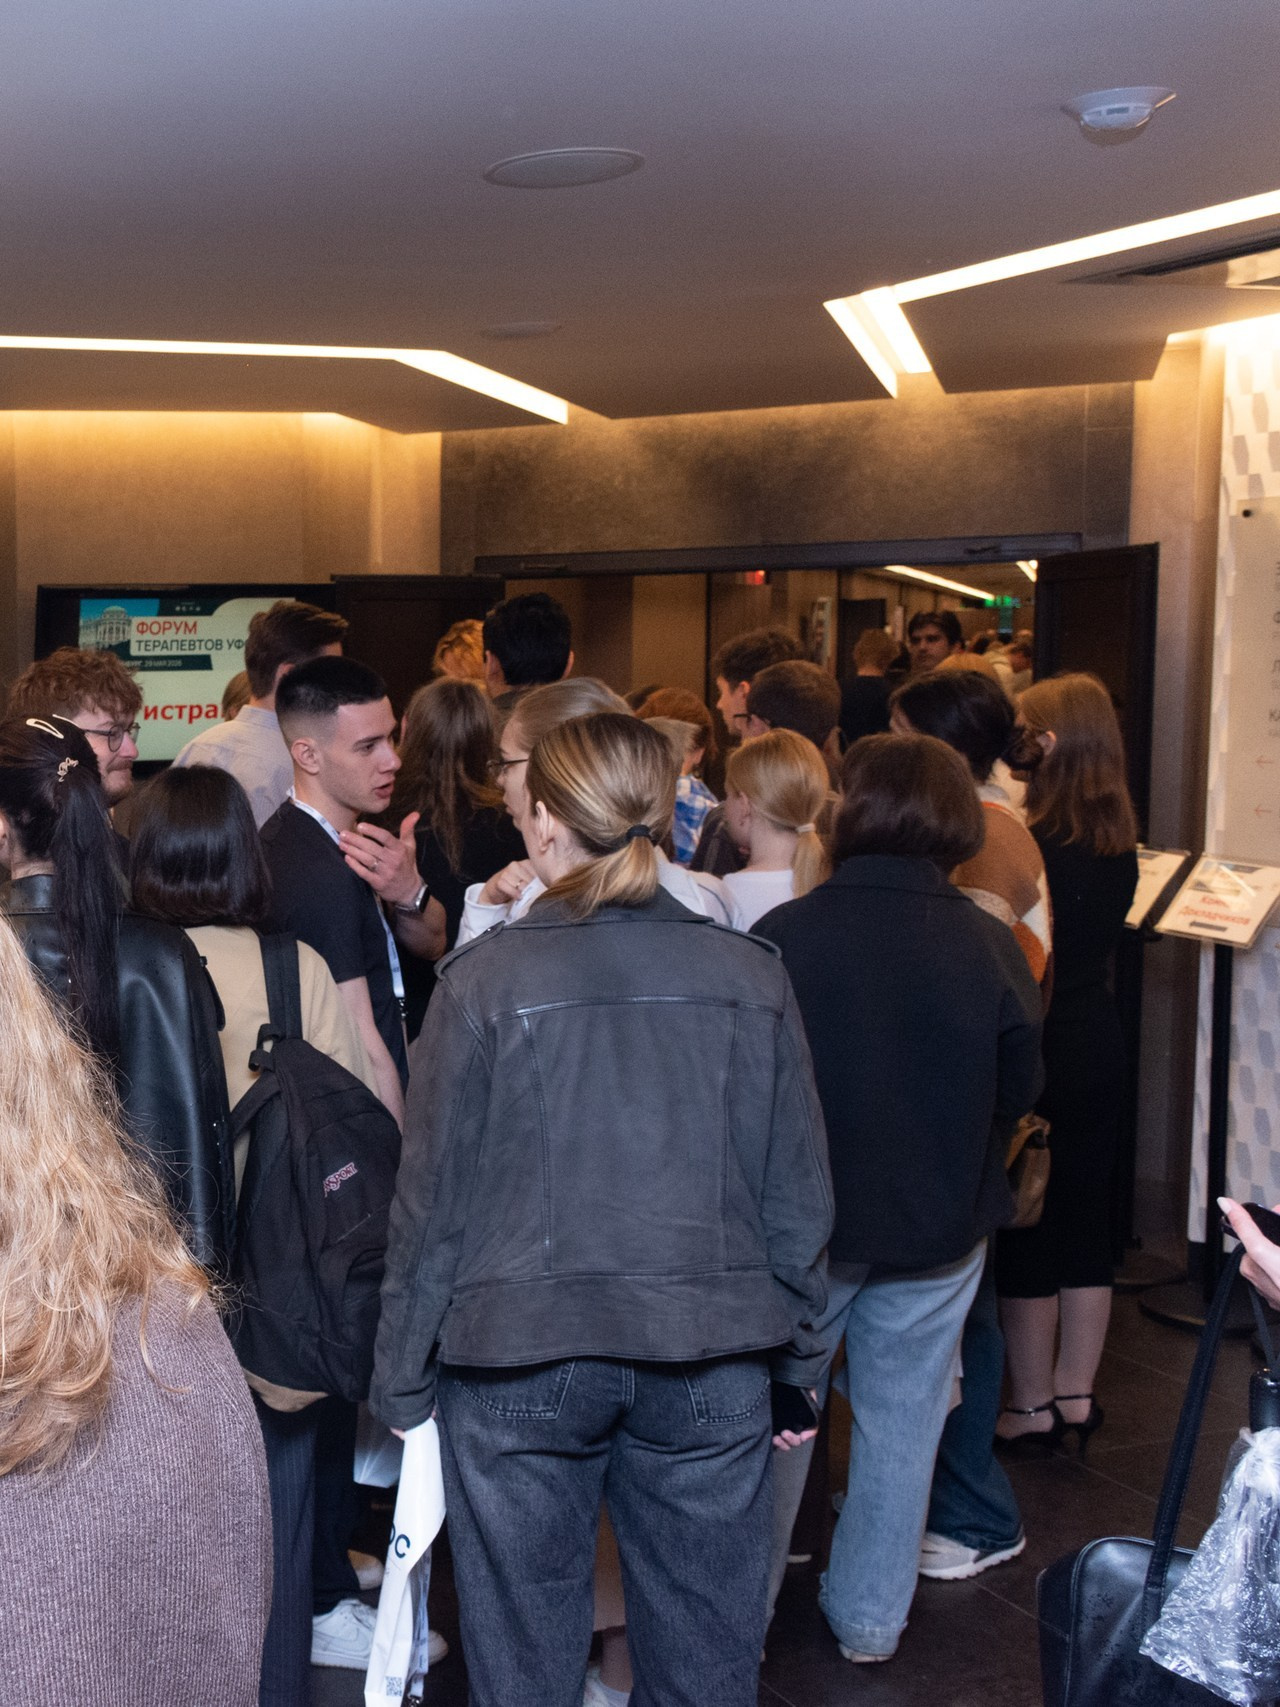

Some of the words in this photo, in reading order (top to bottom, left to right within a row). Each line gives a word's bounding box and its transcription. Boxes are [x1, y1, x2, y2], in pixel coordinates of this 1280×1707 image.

[136, 620, 198, 636] ФОРУМ
[136, 638, 223, 652] ТЕРАПЕВТОВ
[225, 638, 246, 651] УФ
[143, 702, 224, 724] истра
